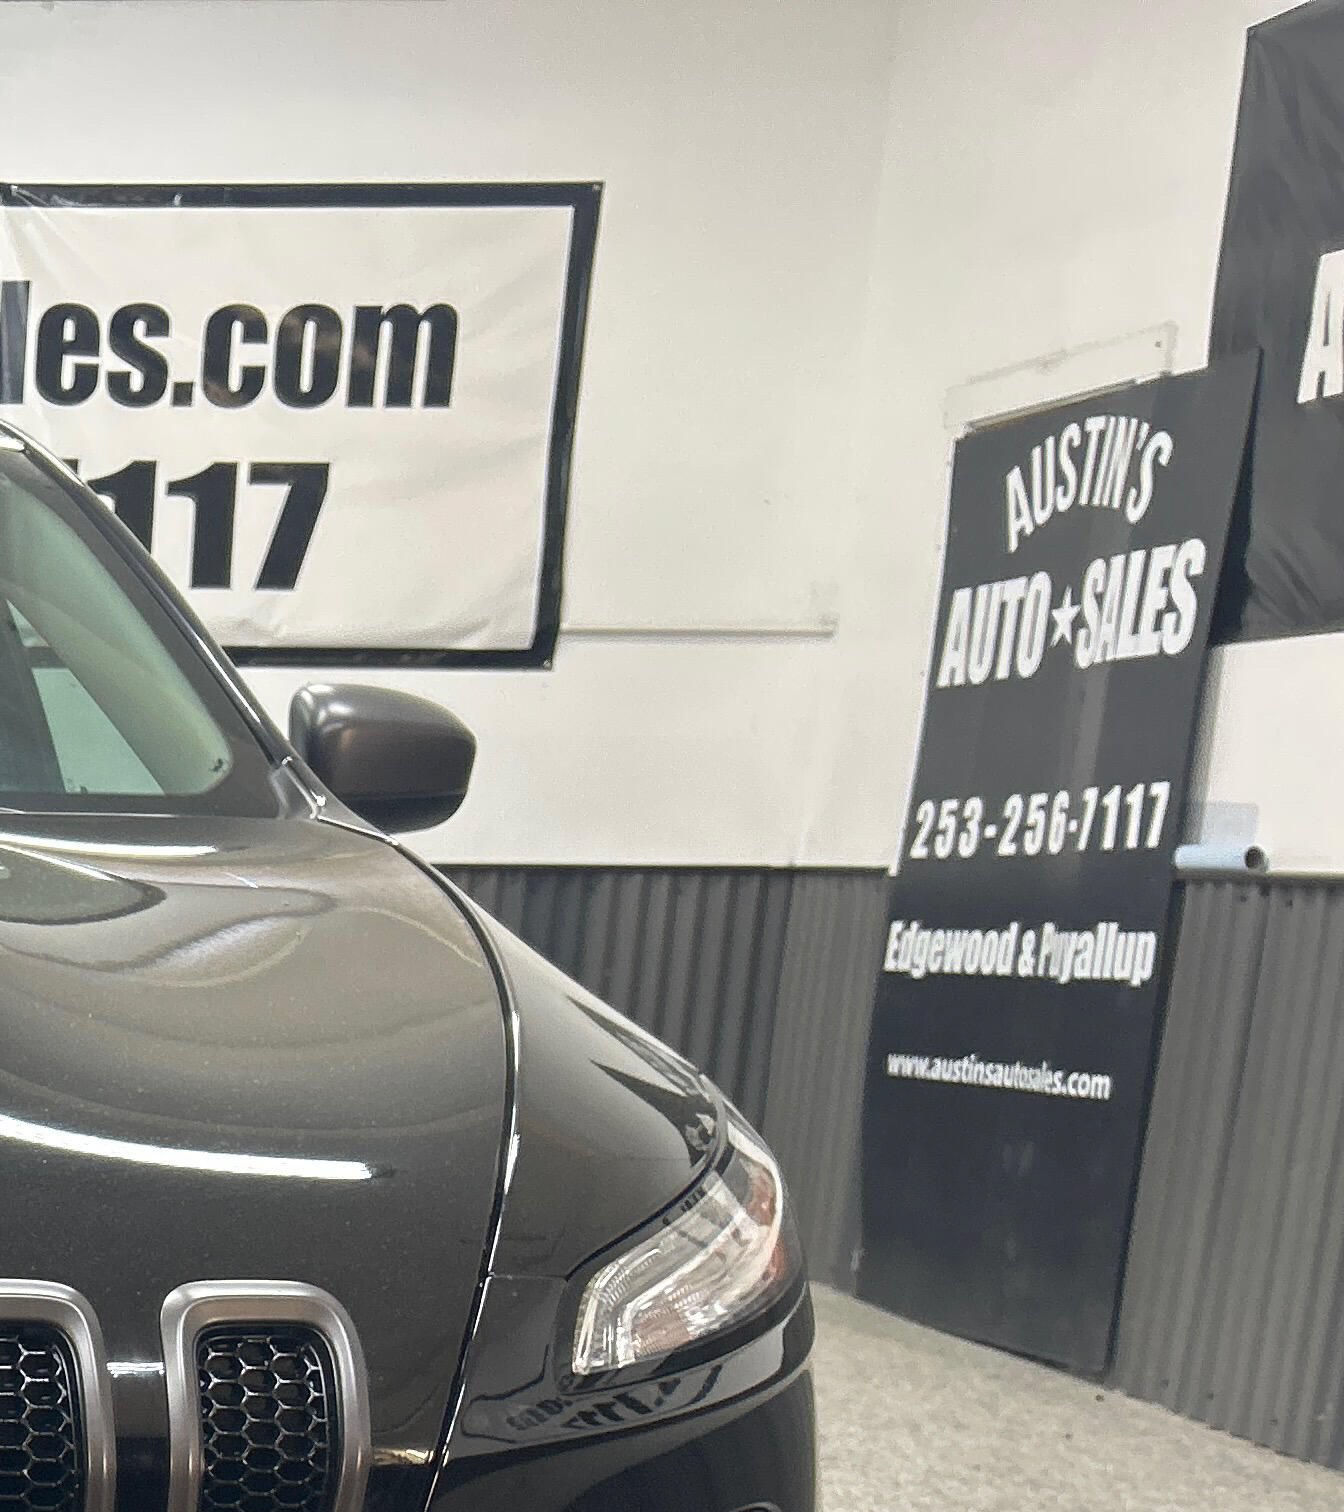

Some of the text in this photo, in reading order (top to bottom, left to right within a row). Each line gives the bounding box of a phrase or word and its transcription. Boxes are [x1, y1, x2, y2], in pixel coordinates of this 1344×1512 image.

[1006, 415, 1173, 553] AUSTIN'S
[937, 538, 1207, 687] AUTO SALES
[911, 782, 1170, 859] 253-256-7117
[883, 920, 1157, 987] Edgewood & Puyallup
[886, 1053, 1112, 1100] www.austinsautosales.com
